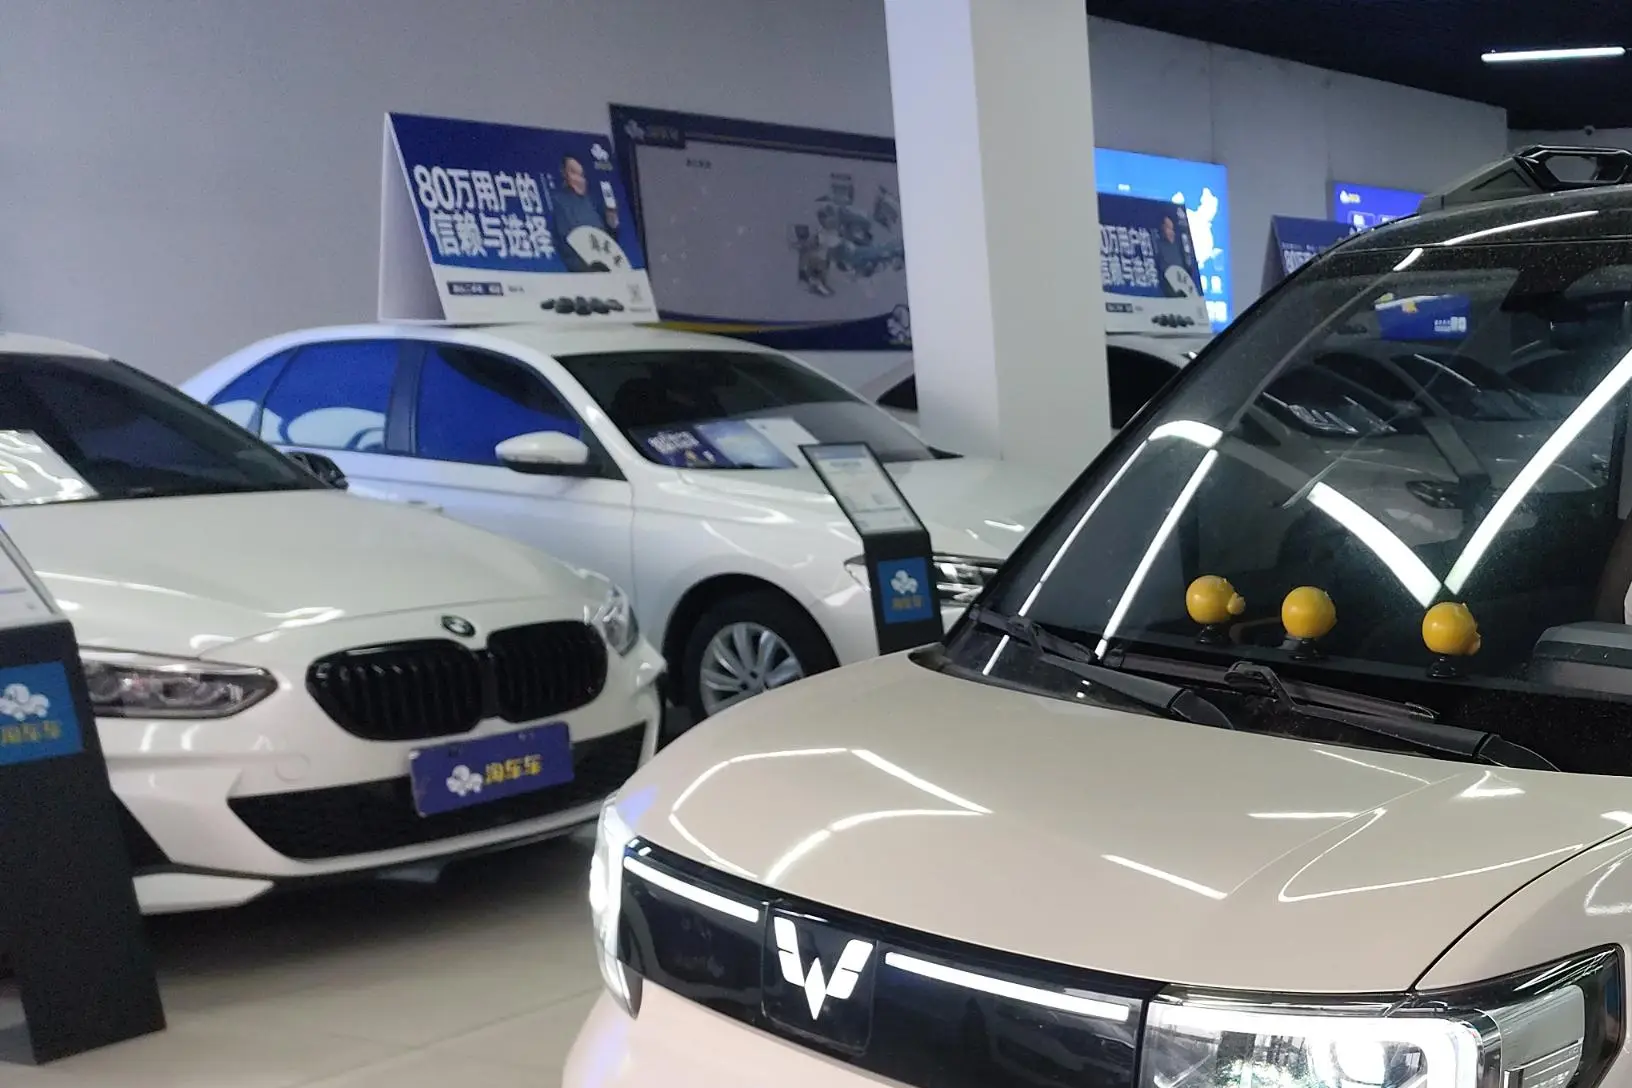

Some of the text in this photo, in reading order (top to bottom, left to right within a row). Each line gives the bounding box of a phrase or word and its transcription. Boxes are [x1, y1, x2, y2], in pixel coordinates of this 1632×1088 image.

[412, 164, 544, 214] 80万用户的
[429, 208, 556, 261] 信赖与选择
